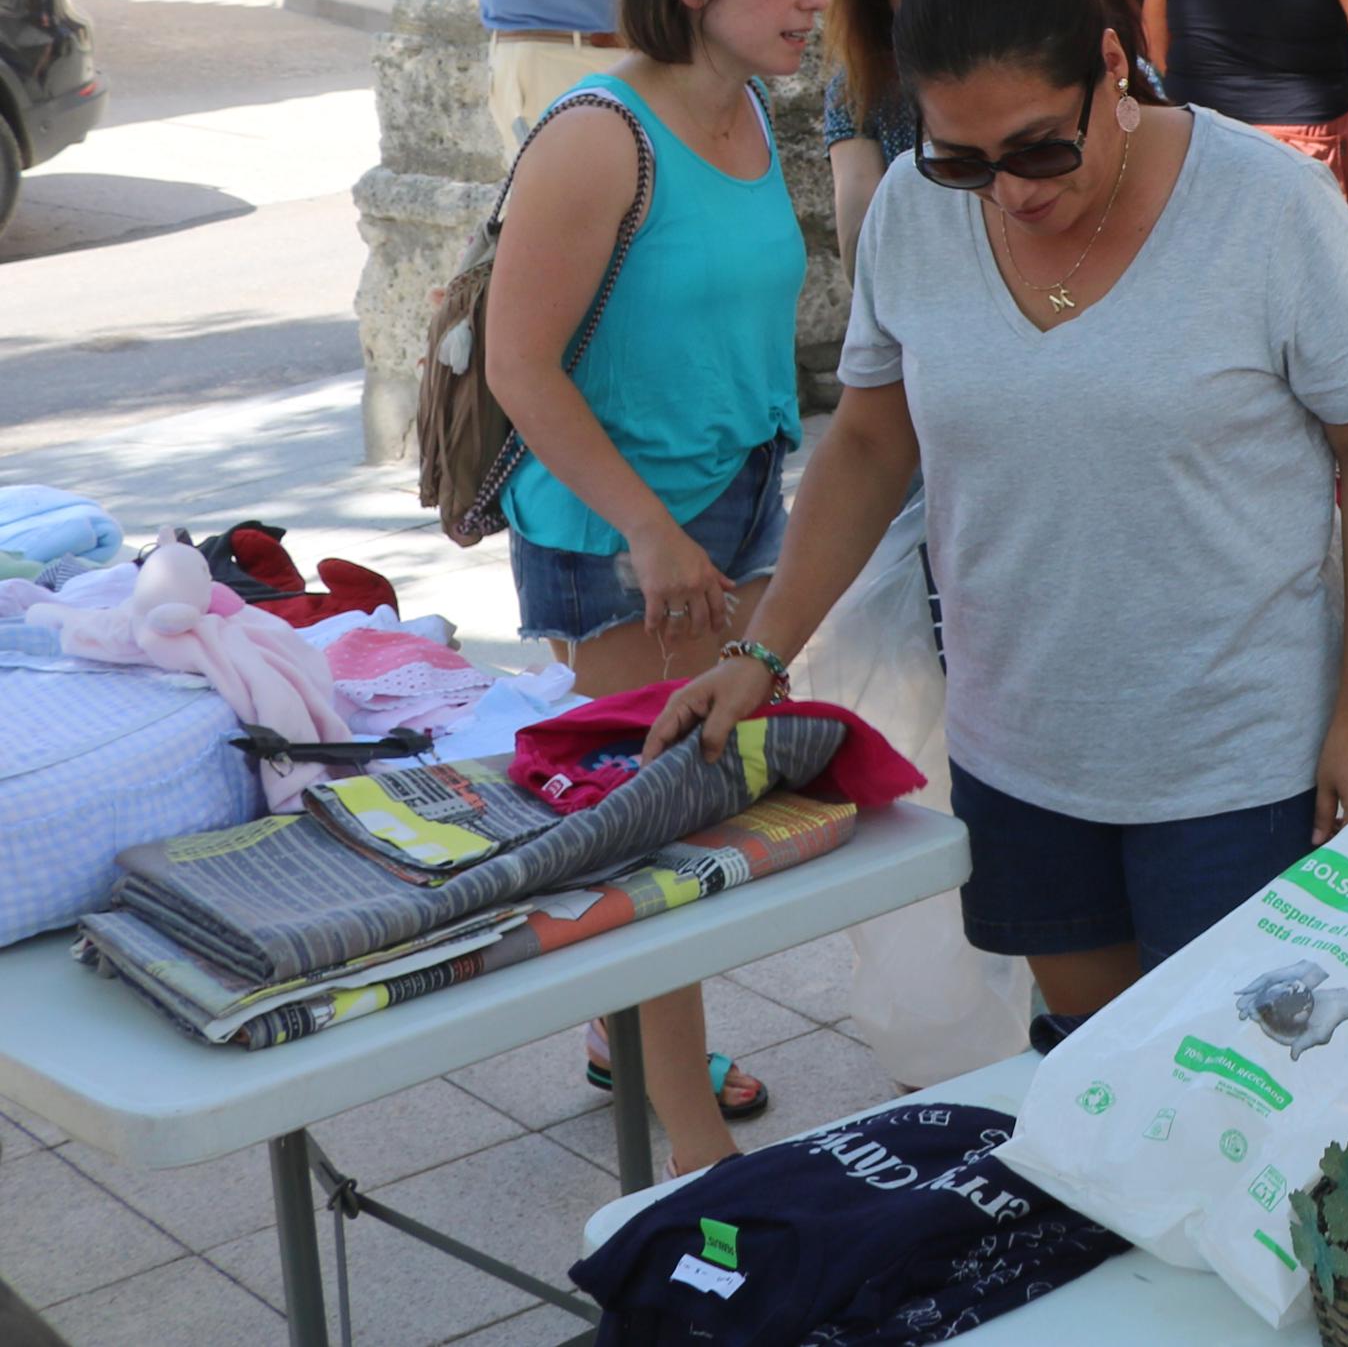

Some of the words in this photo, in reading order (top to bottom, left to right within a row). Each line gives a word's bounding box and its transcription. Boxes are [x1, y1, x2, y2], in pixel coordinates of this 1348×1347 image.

[1257, 914, 1292, 942] está
[1291, 934, 1312, 947] en
[1261, 889, 1329, 932] Respetar
[1328, 924, 1347, 938] el
[1235, 1066, 1286, 1105] RECICLADO
